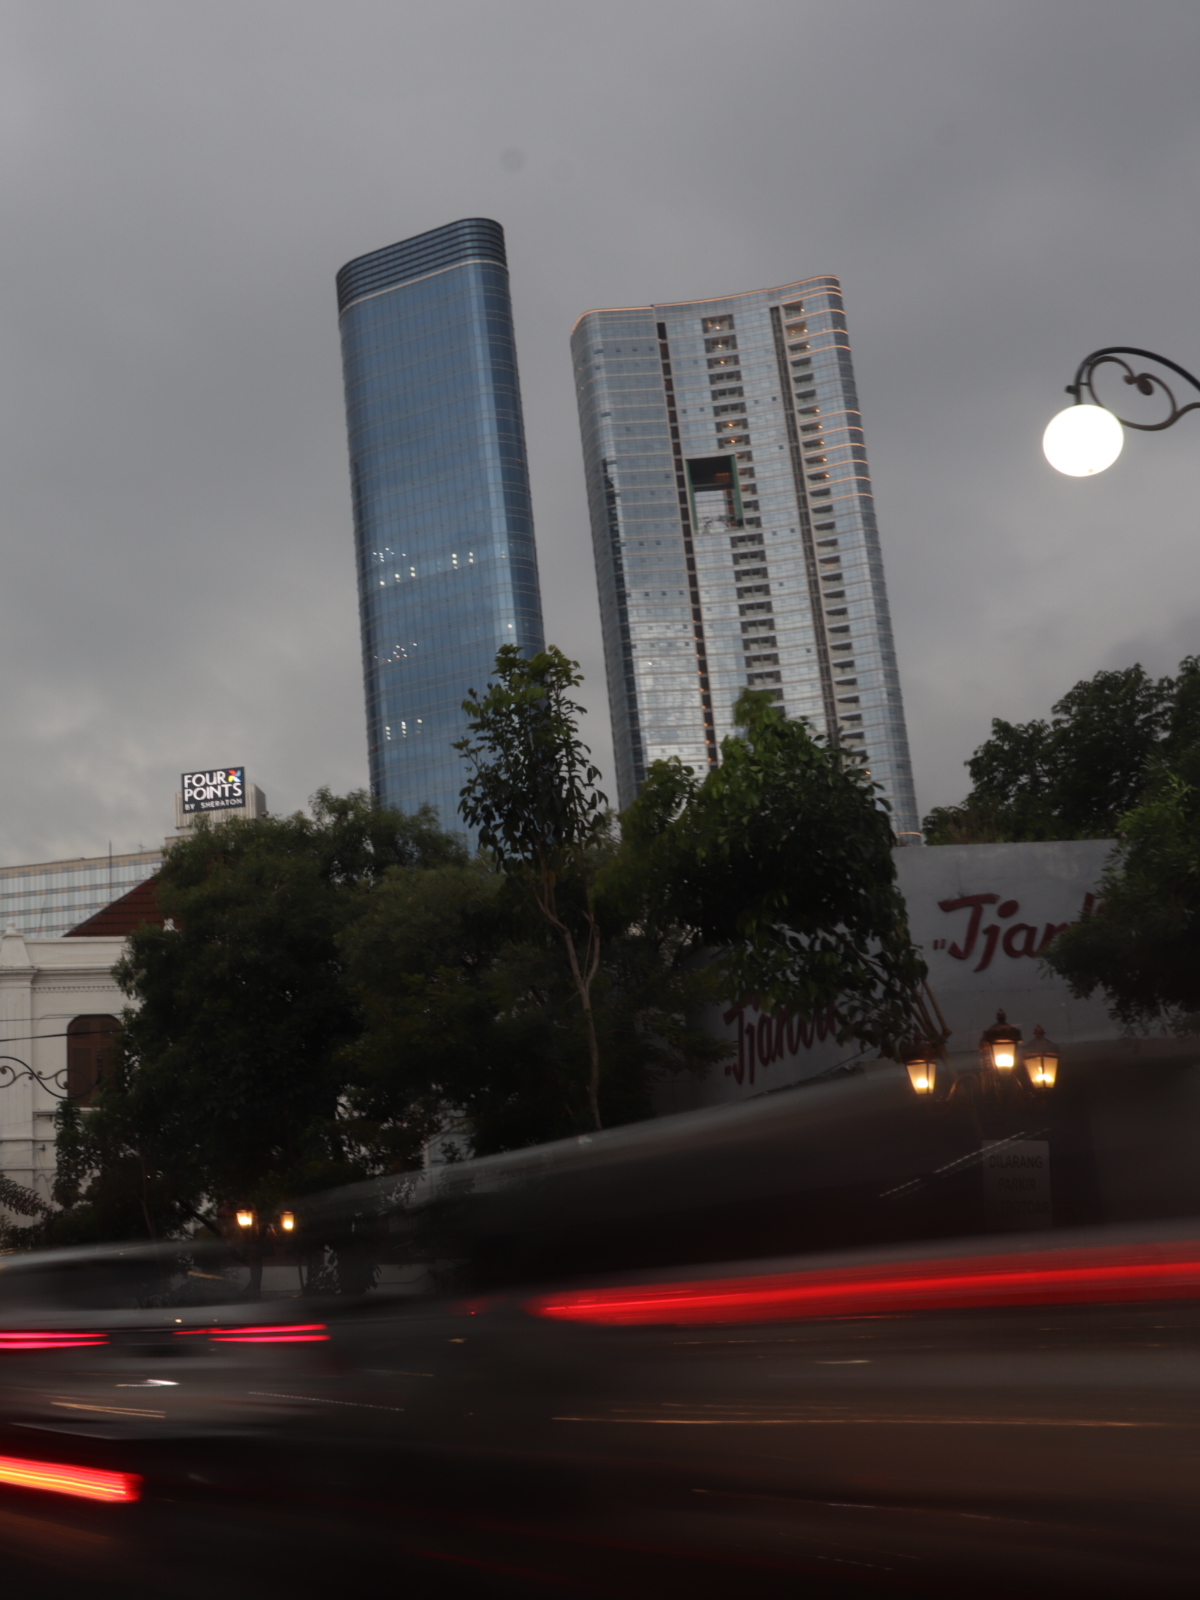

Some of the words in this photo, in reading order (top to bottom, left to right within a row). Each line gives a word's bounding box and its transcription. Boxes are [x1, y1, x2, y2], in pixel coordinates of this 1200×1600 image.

[184, 771, 228, 788] FOUR
[184, 783, 242, 802] POINTS
[184, 803, 195, 811] BY
[201, 798, 242, 809] SHERATON
[989, 1155, 1043, 1169] DILARANG
[998, 1178, 1036, 1192] PARKIR
